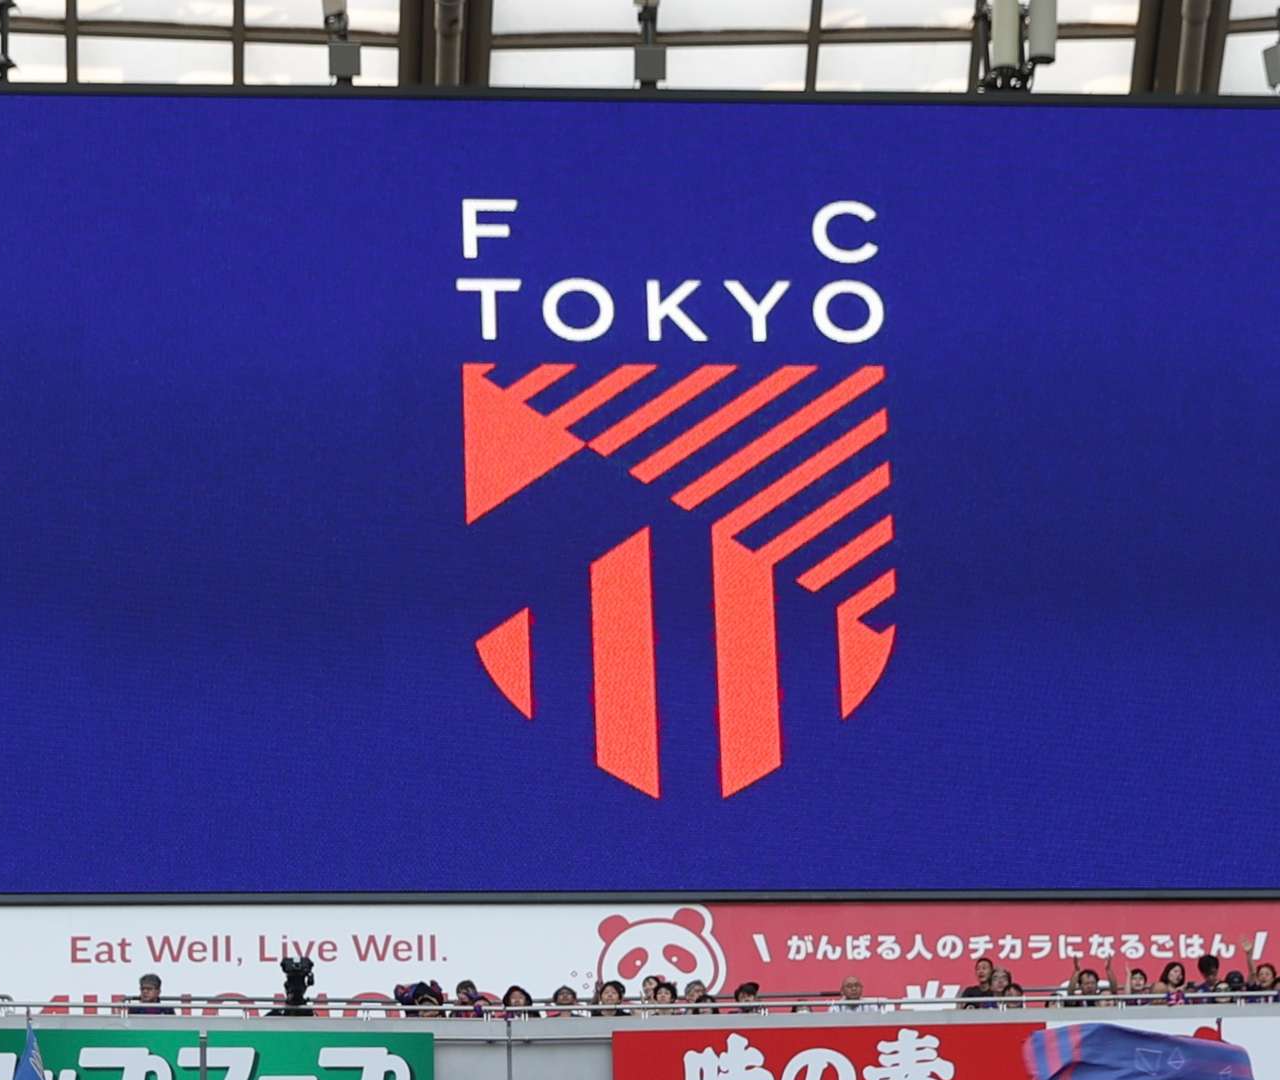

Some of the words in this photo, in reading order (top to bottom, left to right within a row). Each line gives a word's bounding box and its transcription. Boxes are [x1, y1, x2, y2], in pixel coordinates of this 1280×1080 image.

[462, 198, 518, 260] F
[811, 199, 879, 265] C
[455, 276, 886, 344] TOKYO
[69, 935, 132, 964] Eat
[146, 935, 243, 967] Well,
[258, 934, 338, 963] Live
[352, 933, 448, 963] Well.
[786, 932, 1236, 961] がんばる人のチカラになるごはん
